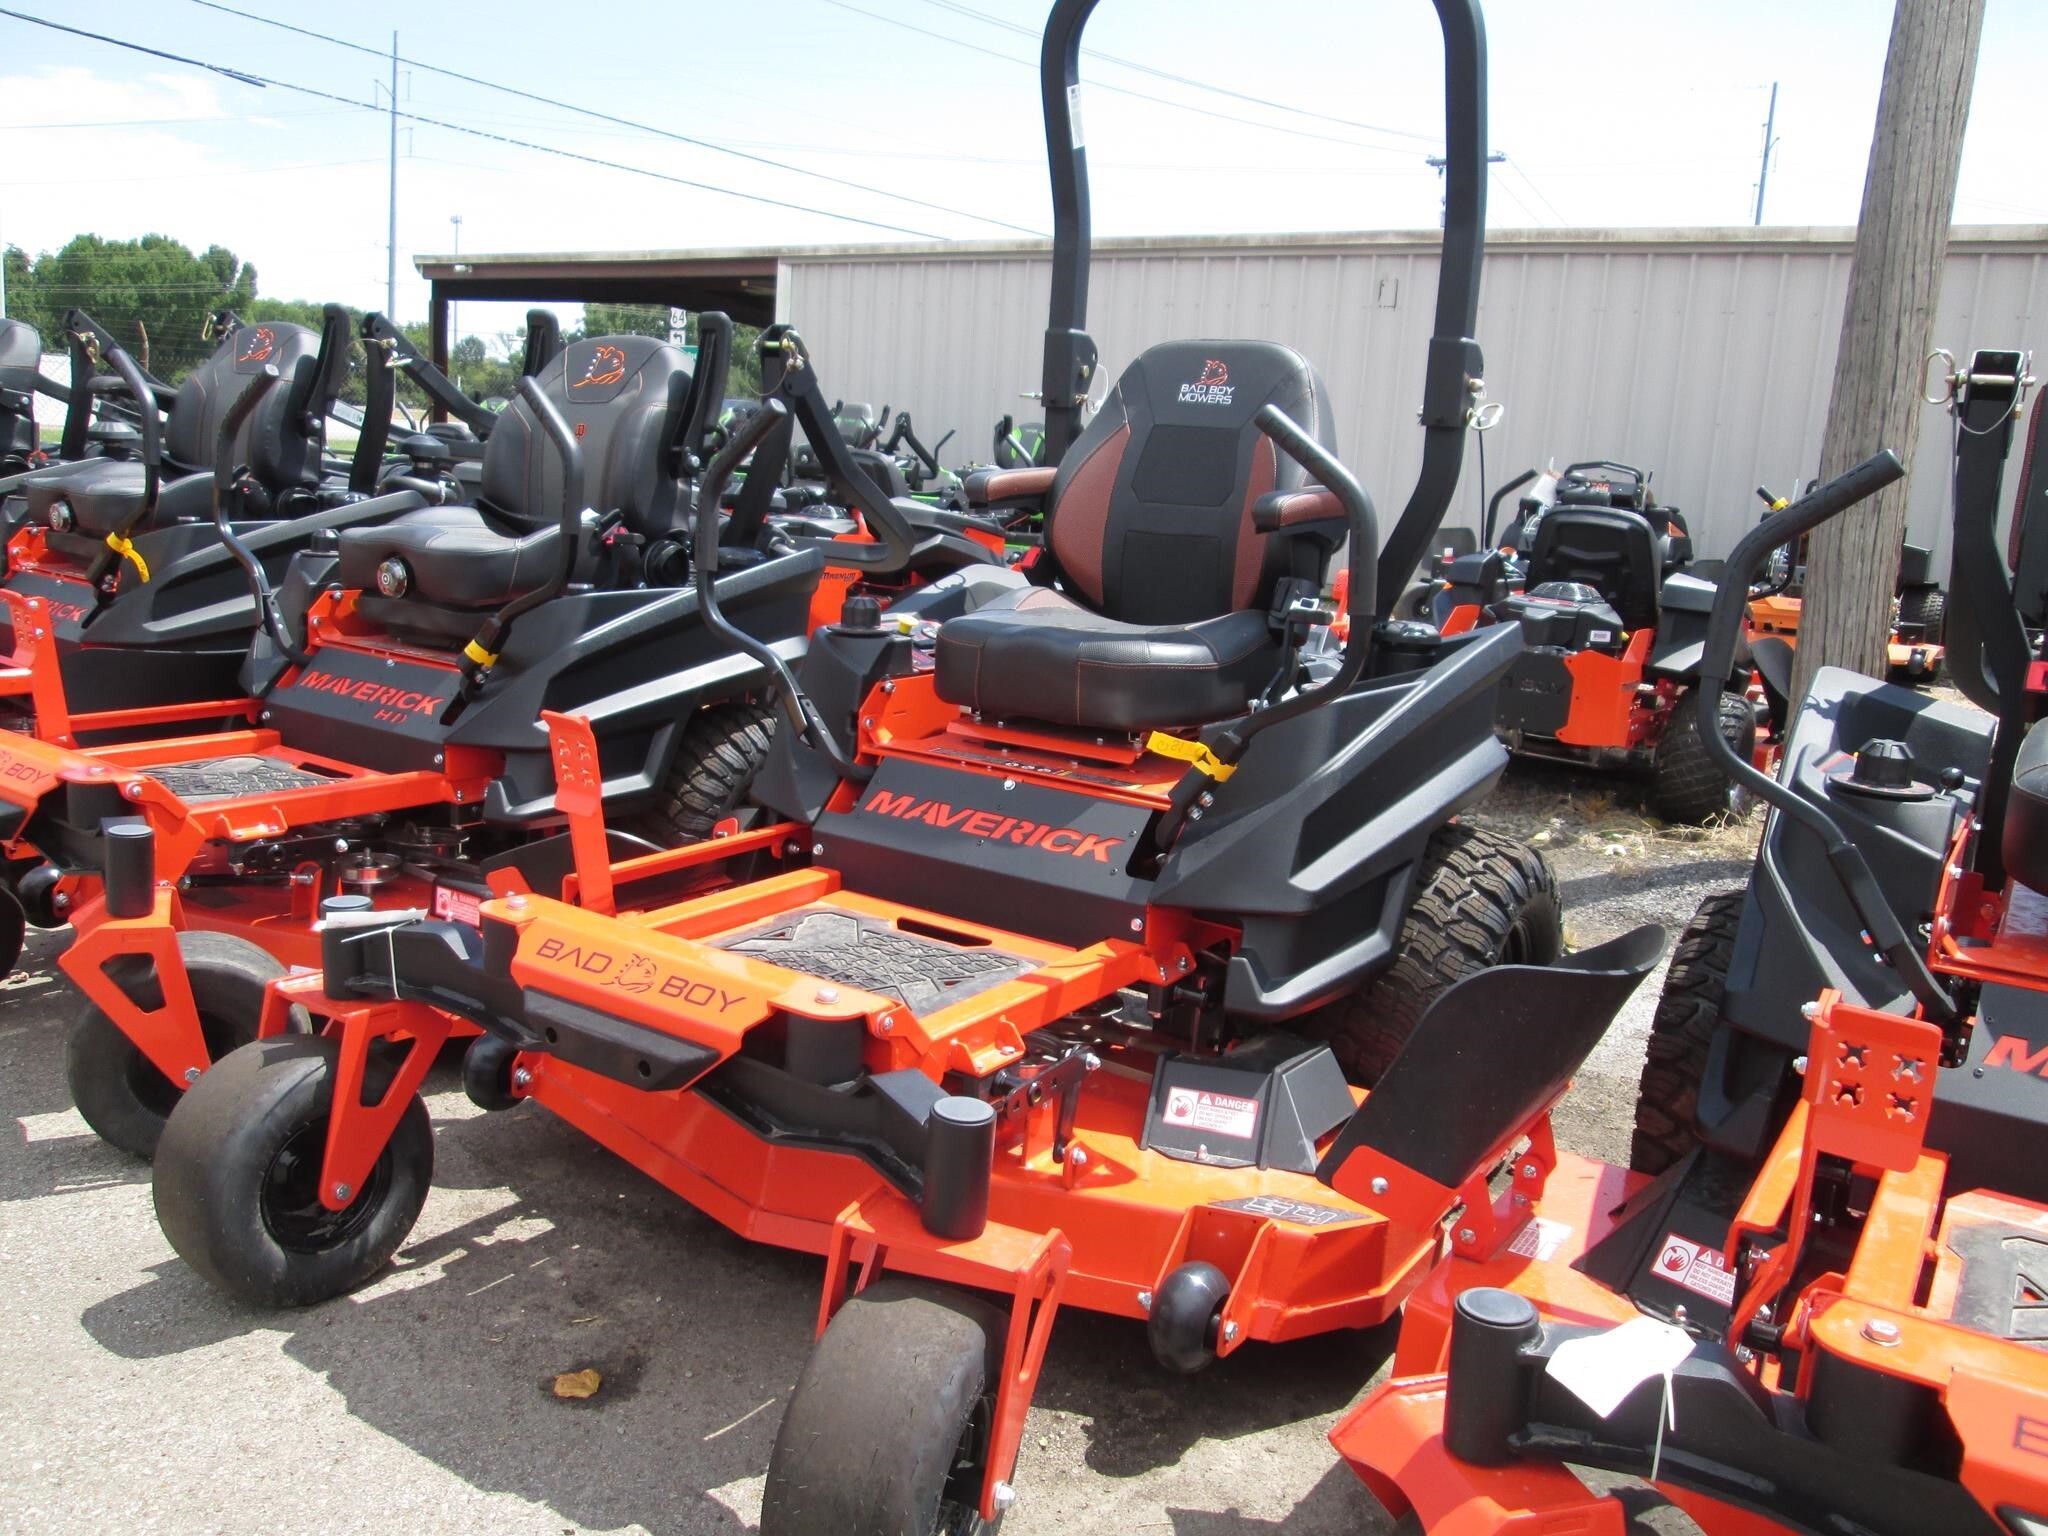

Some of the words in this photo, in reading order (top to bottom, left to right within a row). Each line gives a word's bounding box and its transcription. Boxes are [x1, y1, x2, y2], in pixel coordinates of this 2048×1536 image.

[673, 310, 685, 324] 64
[1178, 393, 1232, 405] MOWERS
[1181, 384, 1206, 393] BAD
[1209, 385, 1235, 395] BOY
[47, 600, 88, 621] RICK
[300, 671, 445, 715] MAVERICK
[4, 762, 51, 784] BOY
[865, 790, 1127, 863] MAVERICK
[536, 938, 613, 974] BAD
[659, 975, 748, 1013] BOY
[1215, 1097, 1254, 1112] DANGER
